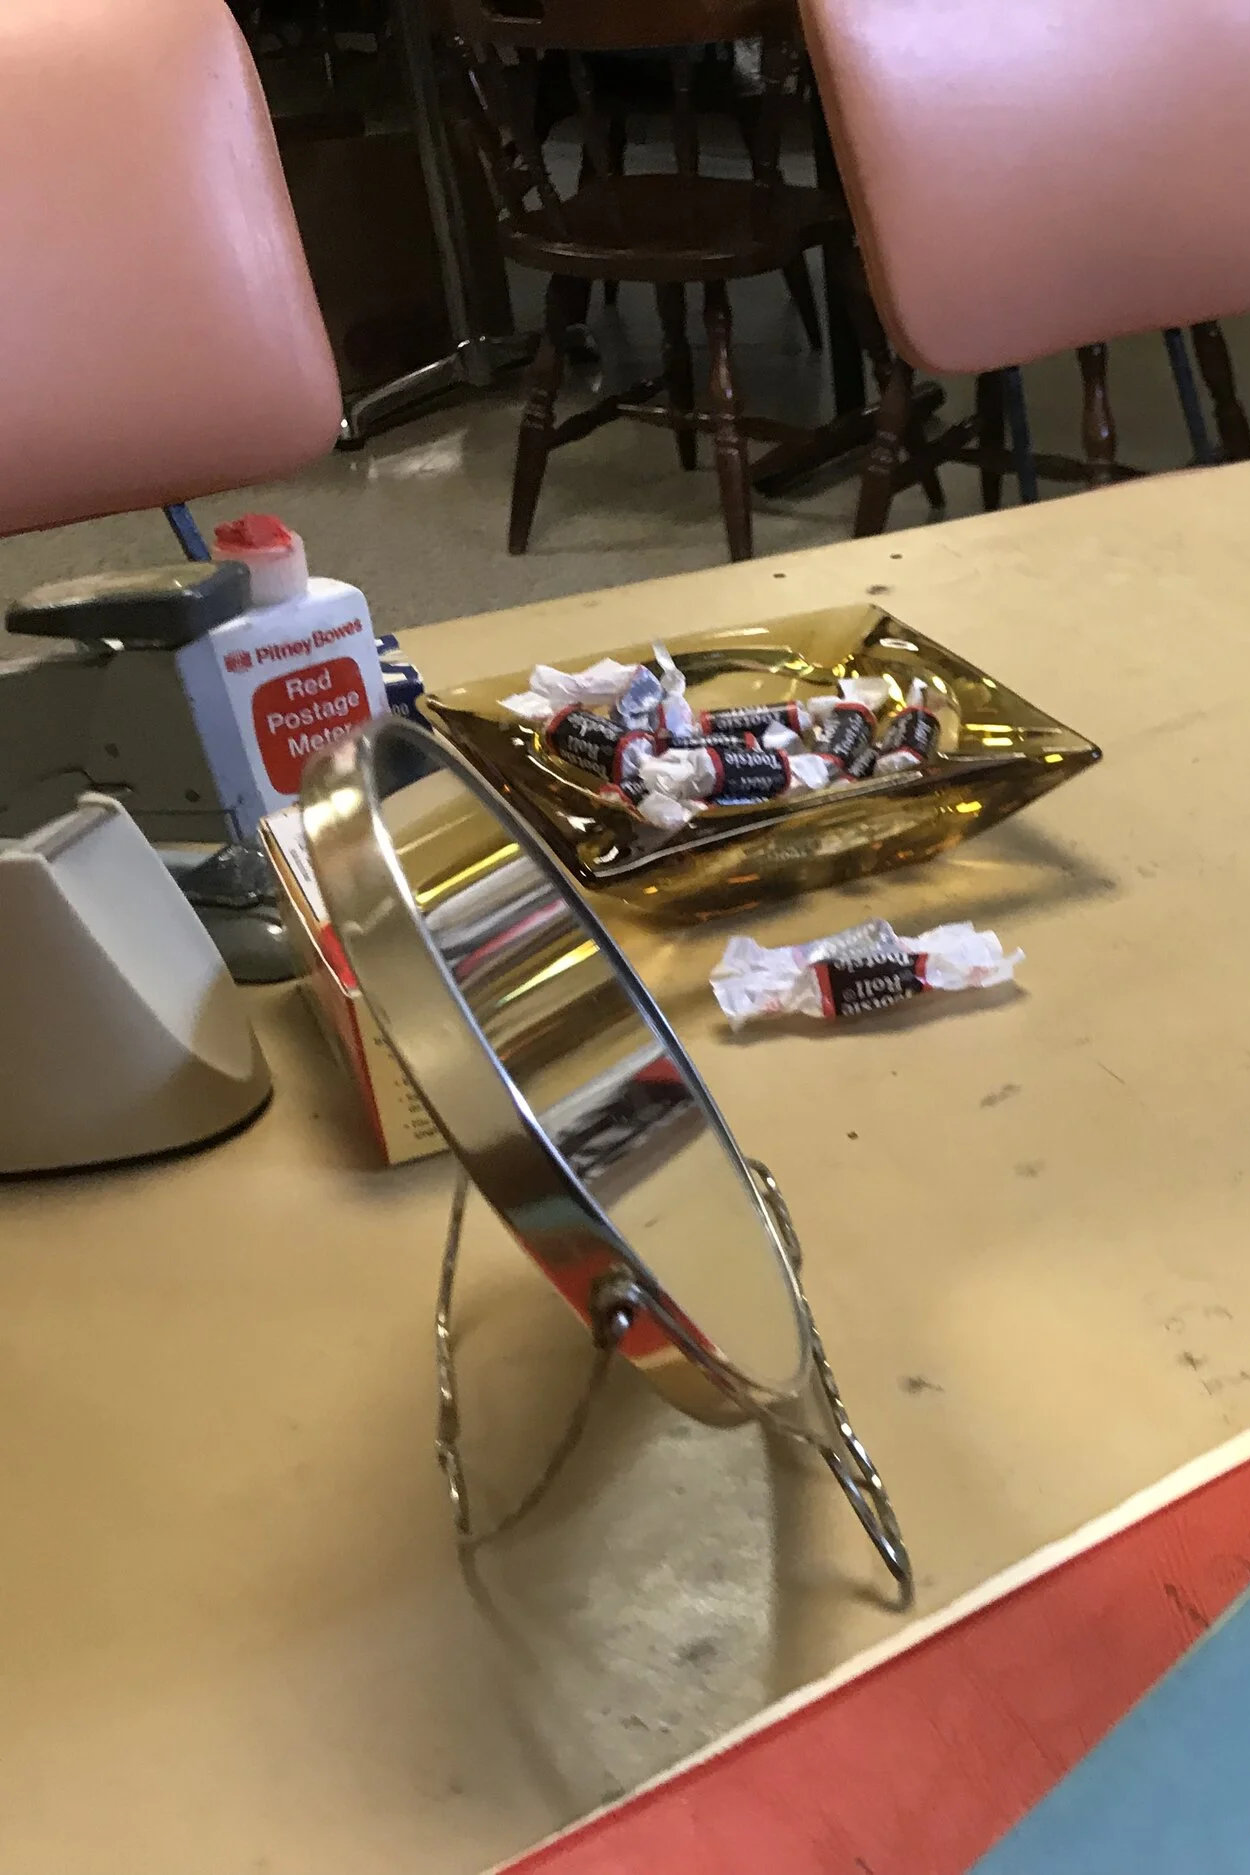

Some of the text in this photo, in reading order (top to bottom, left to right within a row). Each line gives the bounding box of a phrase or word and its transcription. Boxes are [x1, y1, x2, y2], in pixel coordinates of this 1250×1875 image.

[255, 617, 363, 664] Pitney Bowes
[285, 668, 332, 700] Red
[266, 691, 360, 735] Postage
[725, 749, 783, 769] Tootsie
